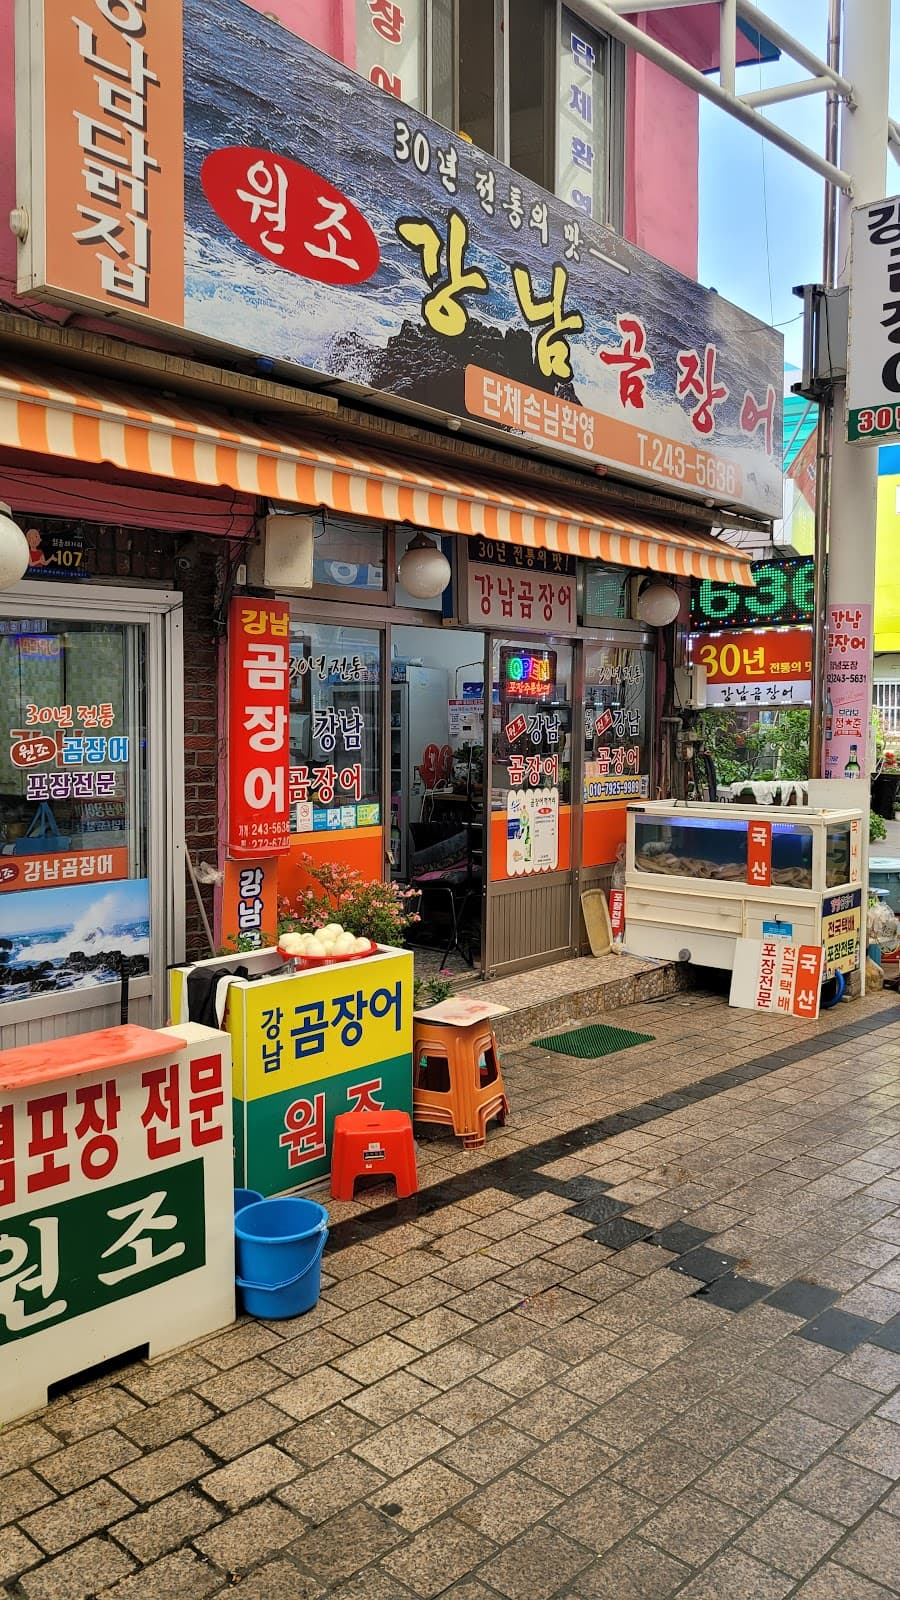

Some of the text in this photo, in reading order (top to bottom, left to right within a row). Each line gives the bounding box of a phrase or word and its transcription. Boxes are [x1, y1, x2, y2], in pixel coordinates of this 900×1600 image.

[394, 119, 457, 195] 30년
[474, 171, 550, 247] 전통의
[236, 159, 361, 271] 원조
[395, 207, 776, 457] 강남 곰장어
[482, 375, 596, 452] 단체손님환영
[636, 432, 736, 496] T.243-5636
[56, 550, 83, 567] 107
[479, 541, 506, 563] 30년
[513, 545, 547, 570] 전통의
[474, 573, 572, 624] 강남곰장어
[241, 609, 290, 637] 강남
[831, 609, 862, 630] 강남
[331, 655, 368, 682] 전통
[508, 656, 550, 681] OPEN
[700, 643, 766, 678] 30년
[769, 660, 802, 675] 전통의
[721, 685, 794, 702] 강남곰장어
[26, 703, 115, 728] 30년 전통
[242, 643, 288, 813] 곰장어
[312, 707, 364, 753] 강남
[526, 712, 561, 744] 강남
[612, 708, 641, 737] 강남
[62, 736, 129, 763] 곰장어
[597, 746, 640, 775] 곰장어
[27, 771, 117, 801] 포장전문
[289, 764, 363, 804] 곰장어
[507, 753, 559, 786] 곰장어
[23, 854, 114, 882] 강남곰장어
[751, 826, 768, 881] 국산
[827, 914, 856, 939] 전국택배
[827, 937, 855, 963] 포장전문
[757, 943, 777, 1008] 포장전문
[777, 946, 796, 1012] 전국택배
[797, 953, 818, 1011] 국산
[290, 980, 402, 1060] 곰장어
[260, 1006, 284, 1074] 강남
[141, 1054, 224, 1160] 전문
[0, 1191, 186, 1333] 원조
